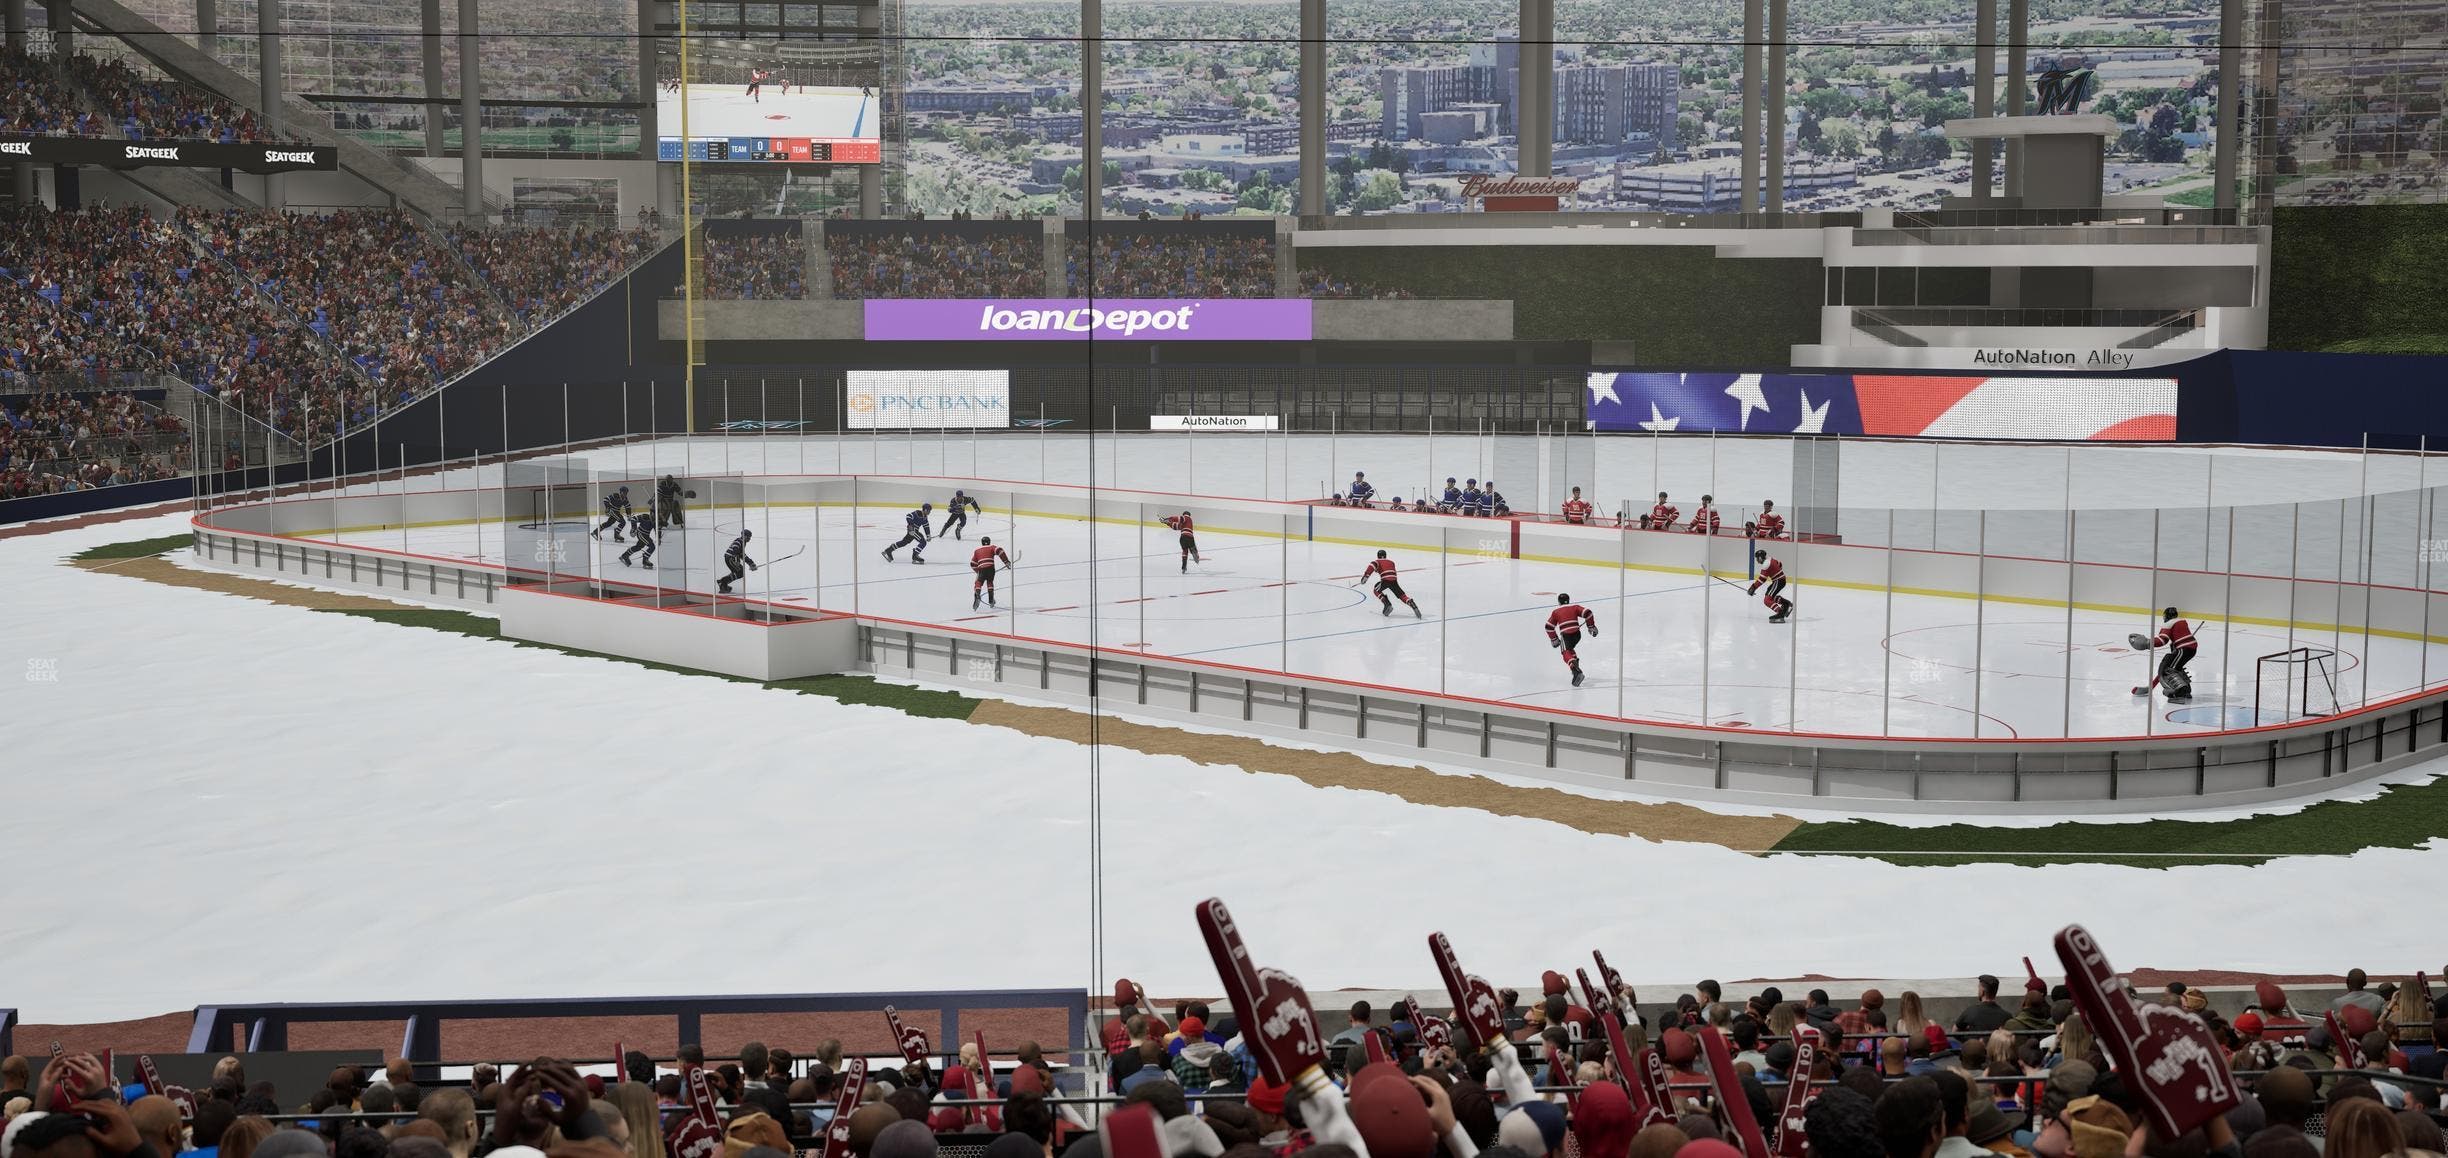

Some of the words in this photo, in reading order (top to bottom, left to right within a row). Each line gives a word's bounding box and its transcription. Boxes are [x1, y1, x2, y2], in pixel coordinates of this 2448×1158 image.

[125, 146, 179, 160] SEATGEEK
[265, 150, 315, 164] SEATGEEK
[1458, 173, 1579, 197] Budweiser
[980, 305, 1193, 336] loanDepot
[1974, 349, 2075, 364] AutoNation
[2088, 349, 2134, 369] Alley
[880, 395, 932, 411] PNC
[938, 393, 1005, 410] BANK
[1181, 416, 1247, 426] AutoNation
